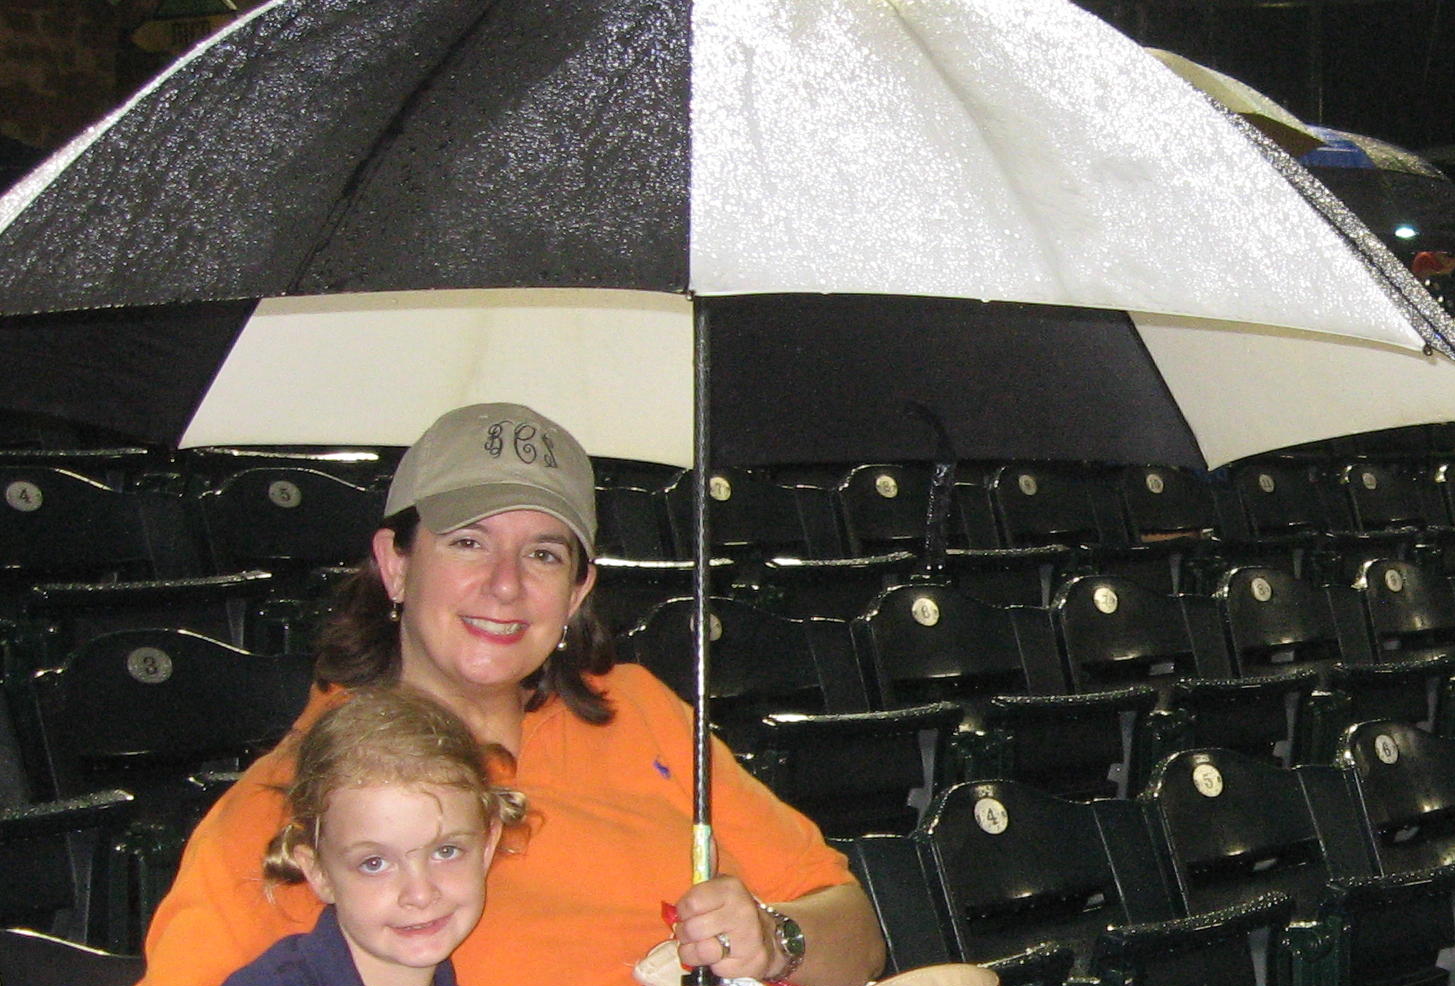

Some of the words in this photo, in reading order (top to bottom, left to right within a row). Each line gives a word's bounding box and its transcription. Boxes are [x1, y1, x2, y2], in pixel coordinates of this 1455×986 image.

[143, 655, 157, 675] 3
[1382, 741, 1392, 757] 6
[1203, 772, 1214, 790] 5
[986, 807, 999, 825] 4
